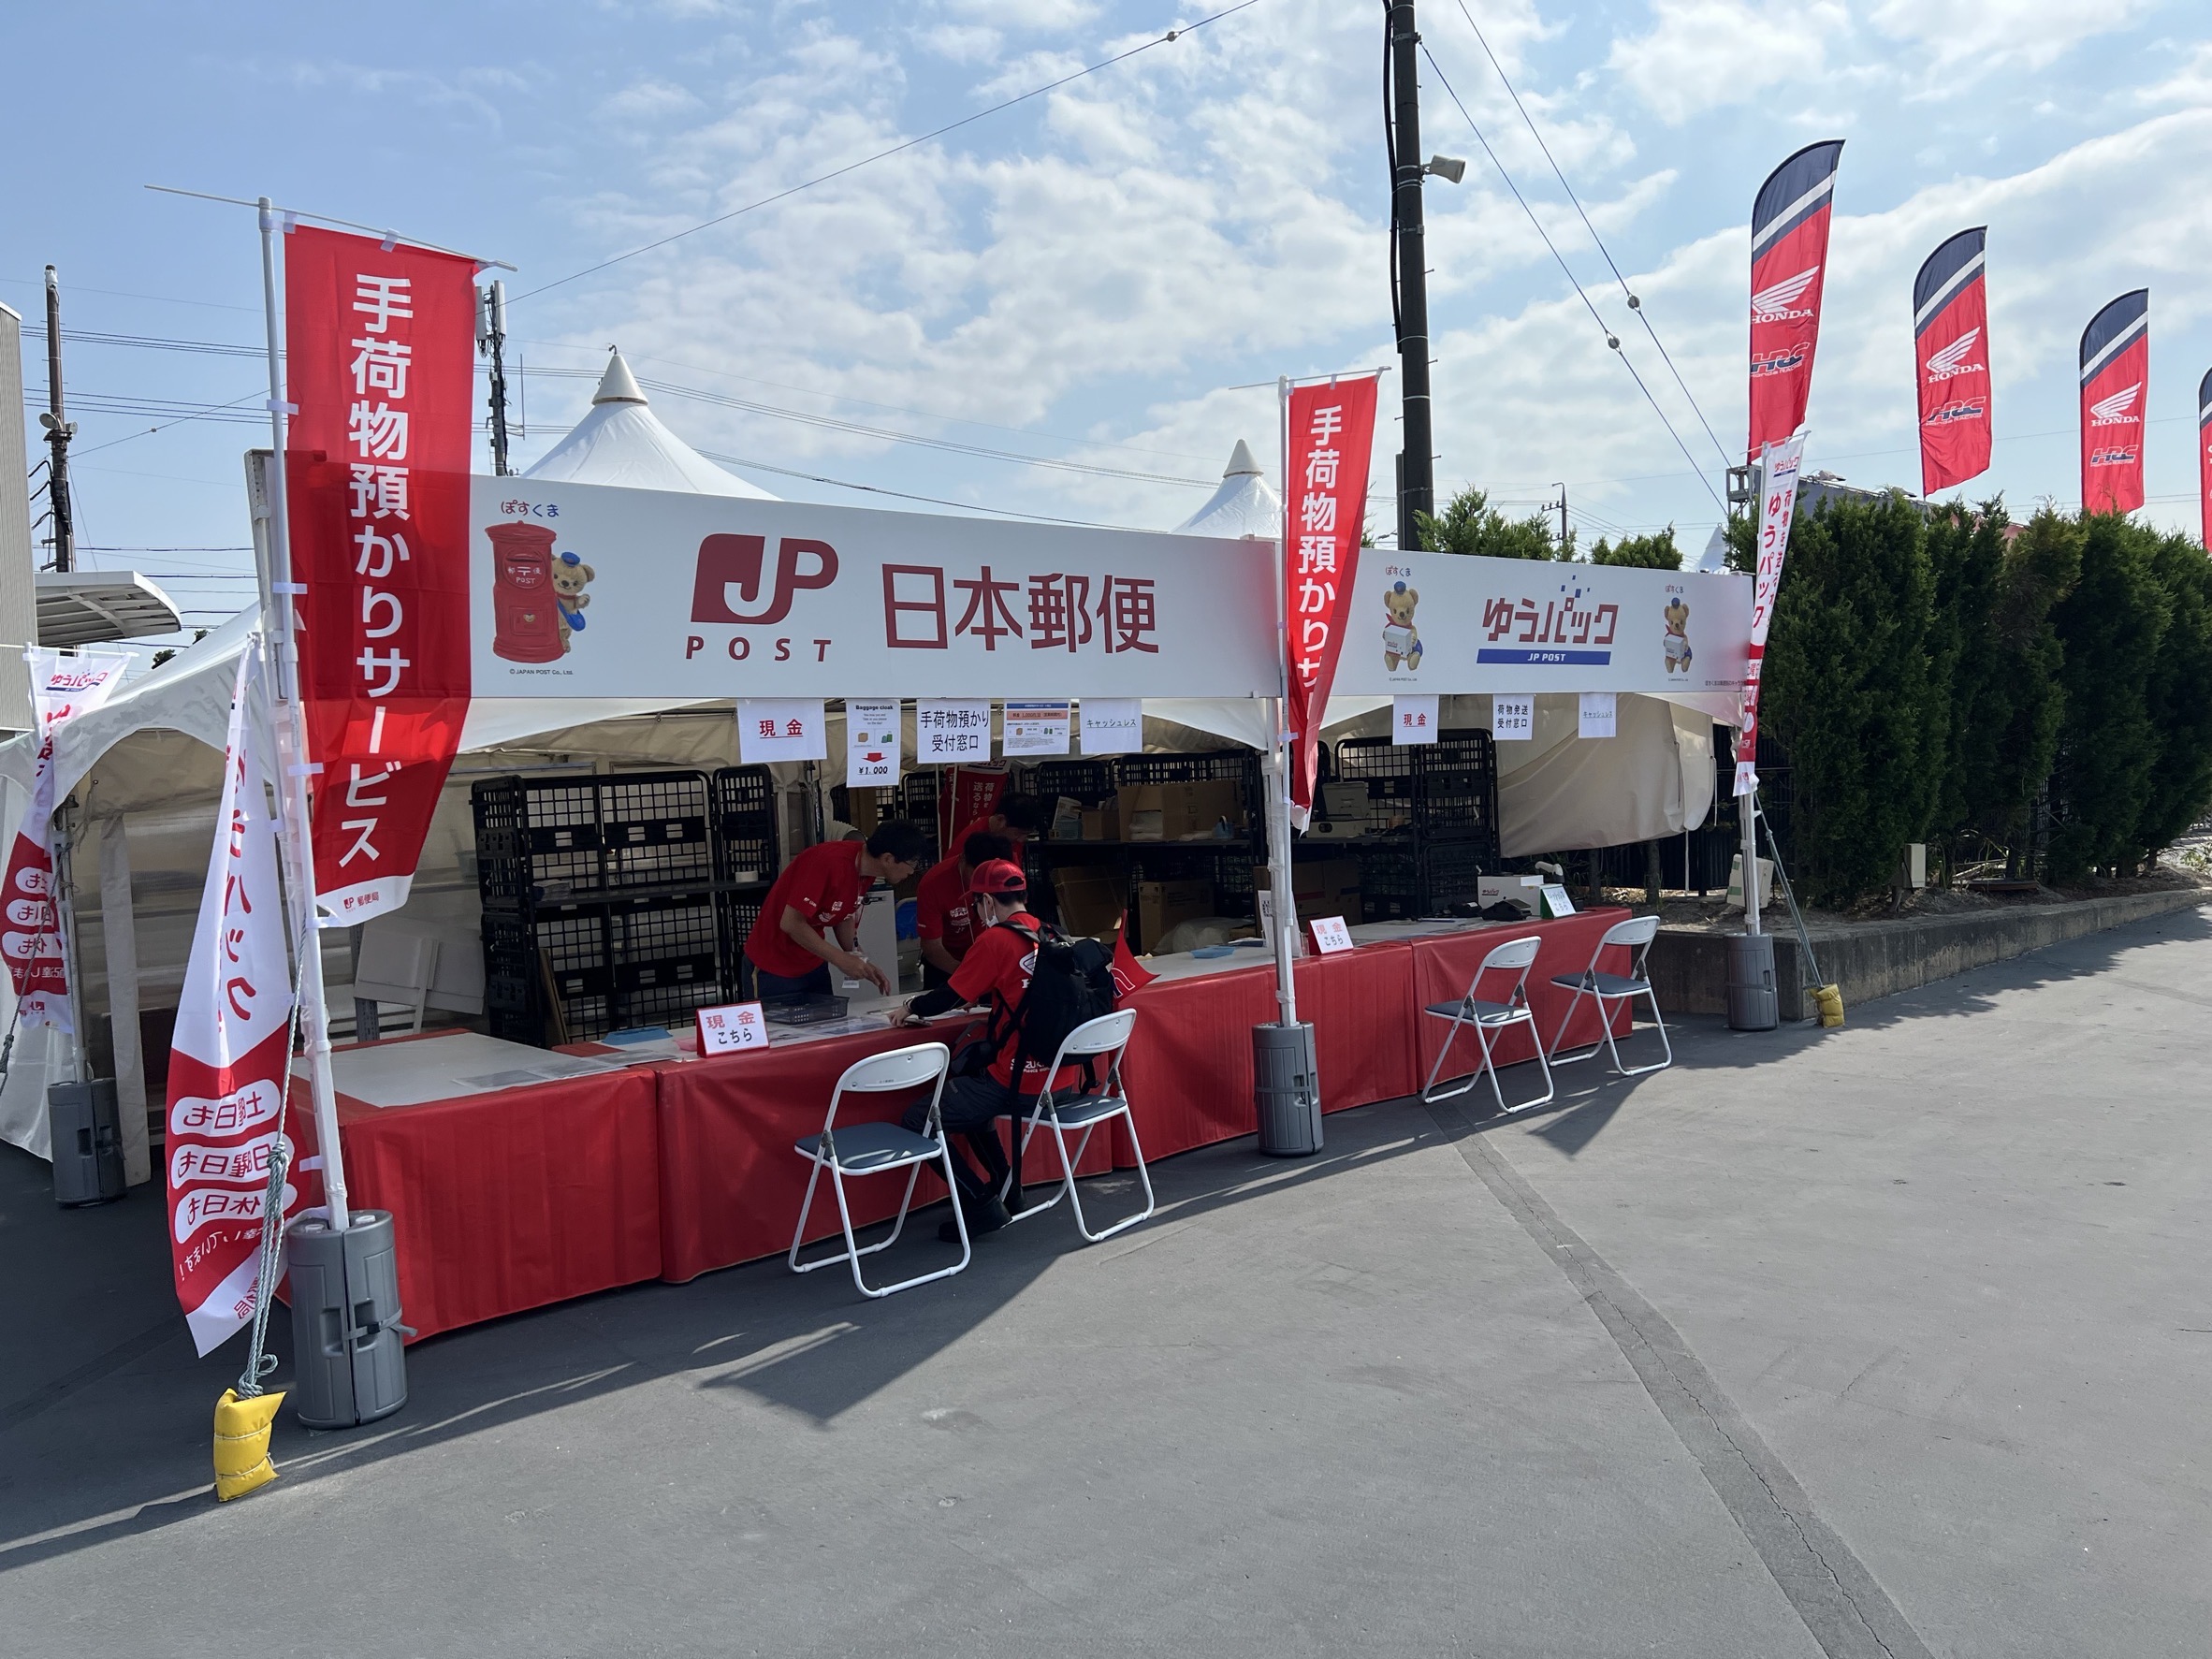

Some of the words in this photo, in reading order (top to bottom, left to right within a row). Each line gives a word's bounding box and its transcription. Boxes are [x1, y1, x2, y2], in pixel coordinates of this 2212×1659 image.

[1752, 309, 1814, 324] HONDA
[1751, 342, 1811, 373] HRC
[1928, 363, 1985, 384] HONDA
[1927, 396, 1986, 422] HRC
[2091, 415, 2140, 427] HONDA
[2090, 444, 2139, 464] HRC
[501, 500, 560, 517] ぽすくま
[1753, 492, 1781, 628] ゆうパック
[339, 273, 413, 867] 手荷物預かりサービス
[691, 533, 838, 624] JP
[1386, 565, 1411, 577] ぽすくま
[881, 563, 1159, 653] 日本郵便
[1482, 596, 1619, 644] ゆうパック
[686, 635, 832, 662] POST
[1527, 653, 1539, 662] JP
[1541, 653, 1566, 662] POST
[1497, 704, 1528, 716] 荷物発送
[1582, 710, 1613, 719] キャッシュレス
[759, 719, 803, 736] 現金
[920, 710, 990, 729] 手荷物預かり
[1086, 719, 1137, 728] キャッシュレス
[1404, 713, 1426, 726] 現金
[1497, 719, 1528, 729] 受付窓口
[931, 735, 979, 752] 受付窓口
[1315, 922, 1343, 935] 現金
[1324, 935, 1344, 946] こちら
[706, 1011, 756, 1029] 現金
[718, 1028, 752, 1045] こちら
